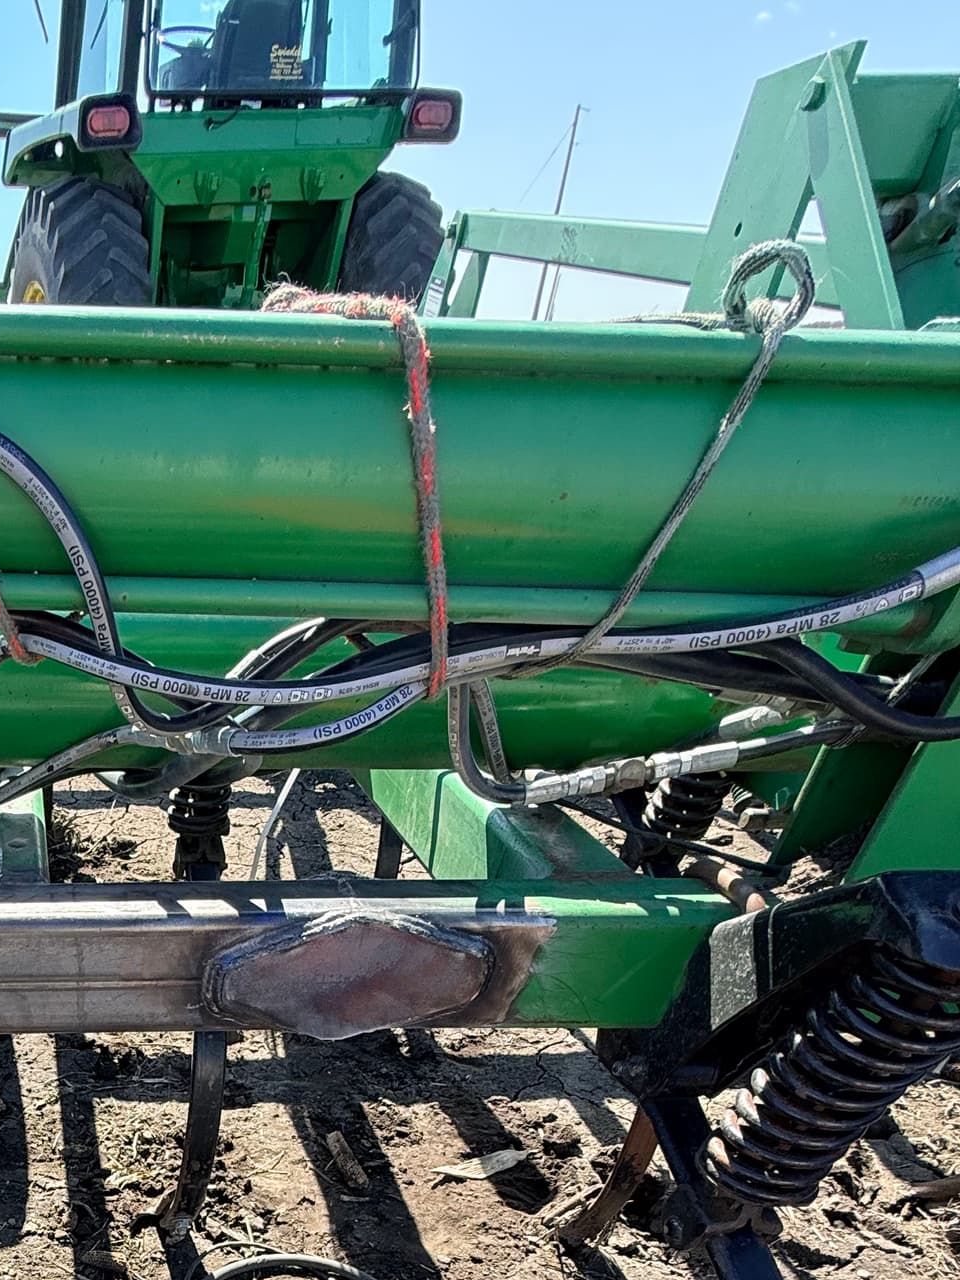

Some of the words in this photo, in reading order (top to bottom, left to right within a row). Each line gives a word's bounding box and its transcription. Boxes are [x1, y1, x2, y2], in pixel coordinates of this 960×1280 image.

[68, 545, 89, 577] PSI)
[82, 580, 104, 620] (4000
[775, 618, 814, 634] MPa
[819, 611, 841, 627] 28
[97, 623, 112, 653] MPa
[689, 634, 722, 648] PSI)
[726, 626, 771, 645] (4000
[131, 671, 159, 689] PSI)
[203, 686, 232, 701] MPa
[235, 689, 251, 702] 28
[399, 685, 414, 699] 28
[376, 694, 401, 713] MPa
[344, 709, 377, 730] (4000
[313, 723, 342, 738] PSI)
